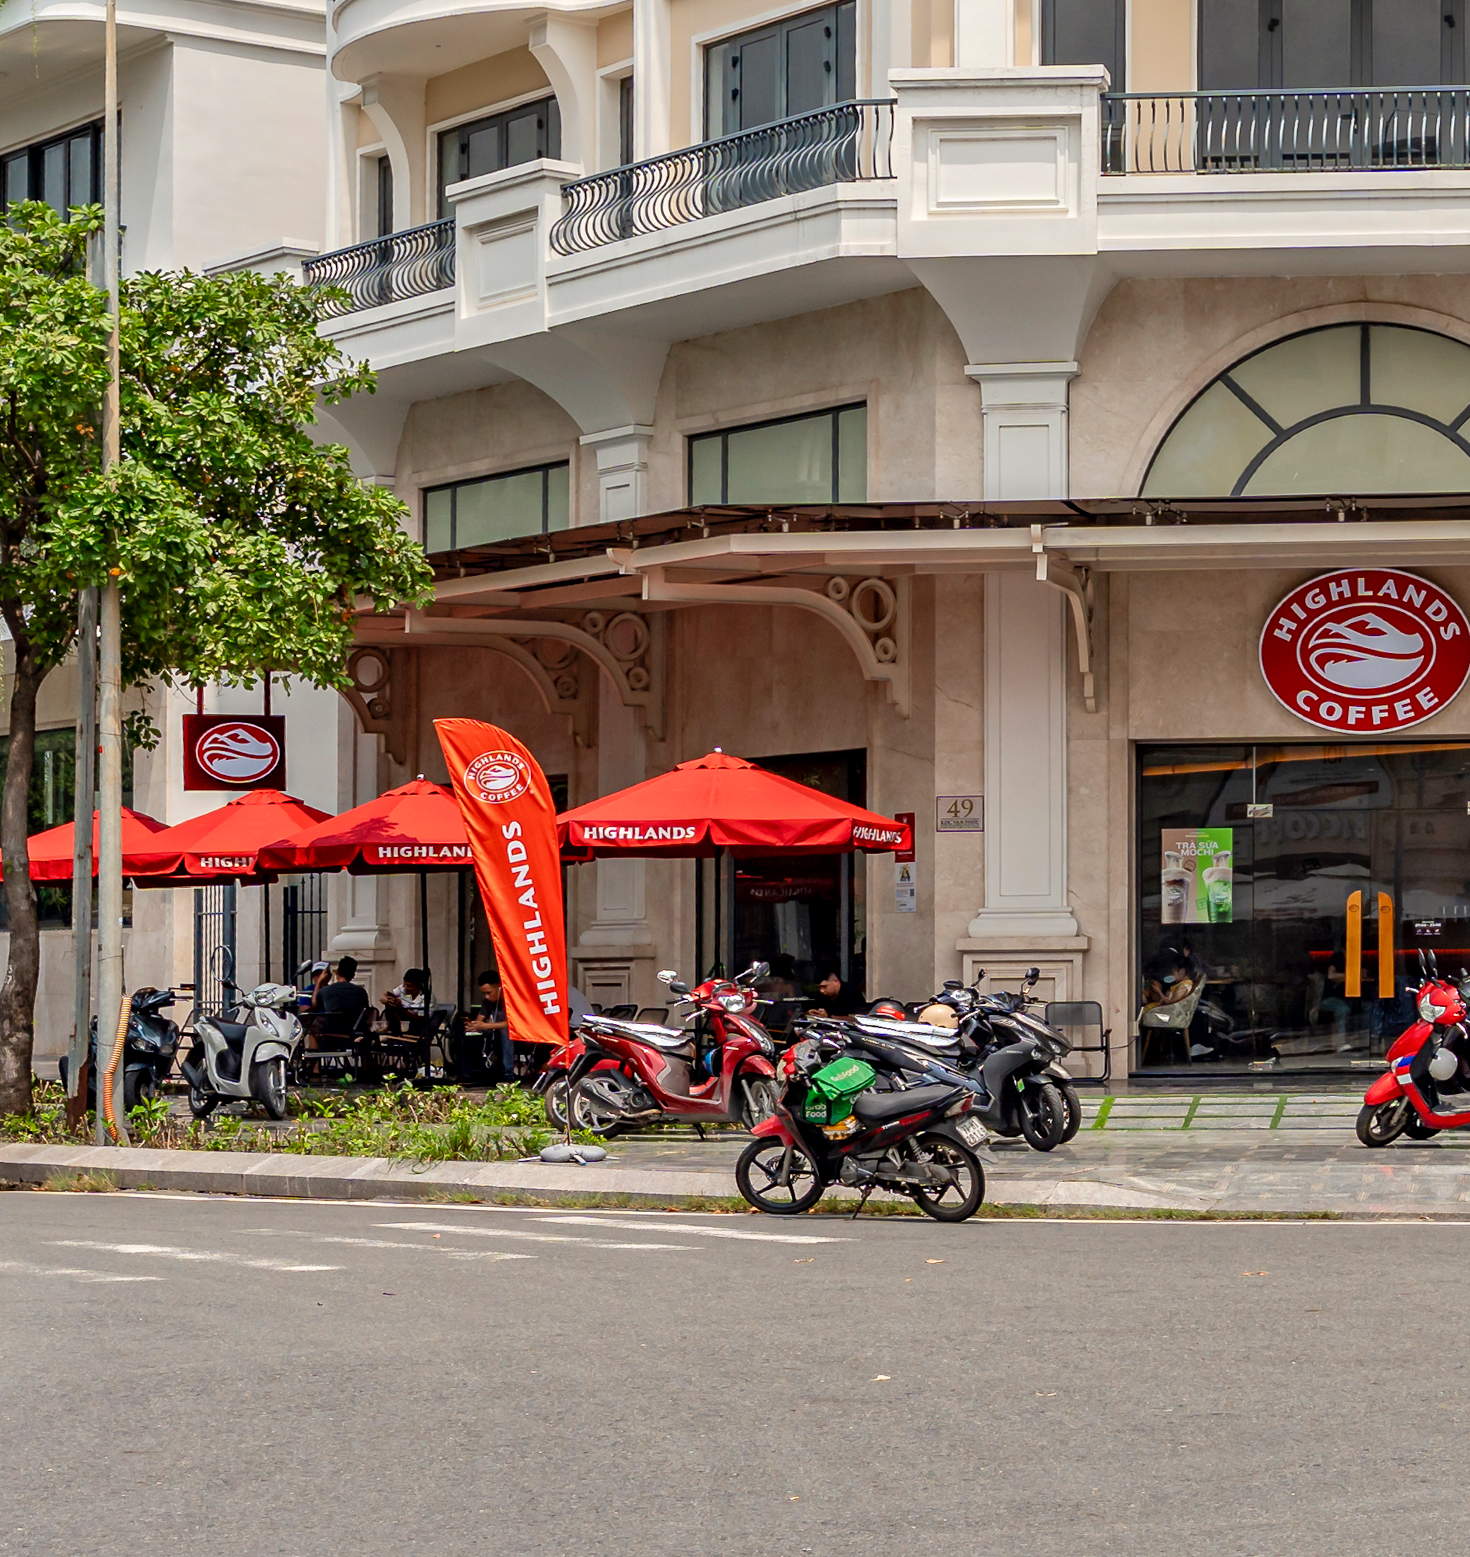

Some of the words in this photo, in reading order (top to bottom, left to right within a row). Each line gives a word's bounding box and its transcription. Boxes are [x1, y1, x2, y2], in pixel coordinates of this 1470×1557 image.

[1273, 577, 1461, 642] HIGHLANDS
[1296, 686, 1439, 725] COFFEE
[467, 753, 525, 780] HIGHLANDS
[480, 783, 524, 801] COFFEE
[947, 799, 974, 817] 49
[583, 826, 696, 840] HIGHLANDS
[852, 825, 902, 844] HIGHLANDS
[502, 820, 561, 1015] HIGHLANDS
[805, 1110, 827, 1118] Food
